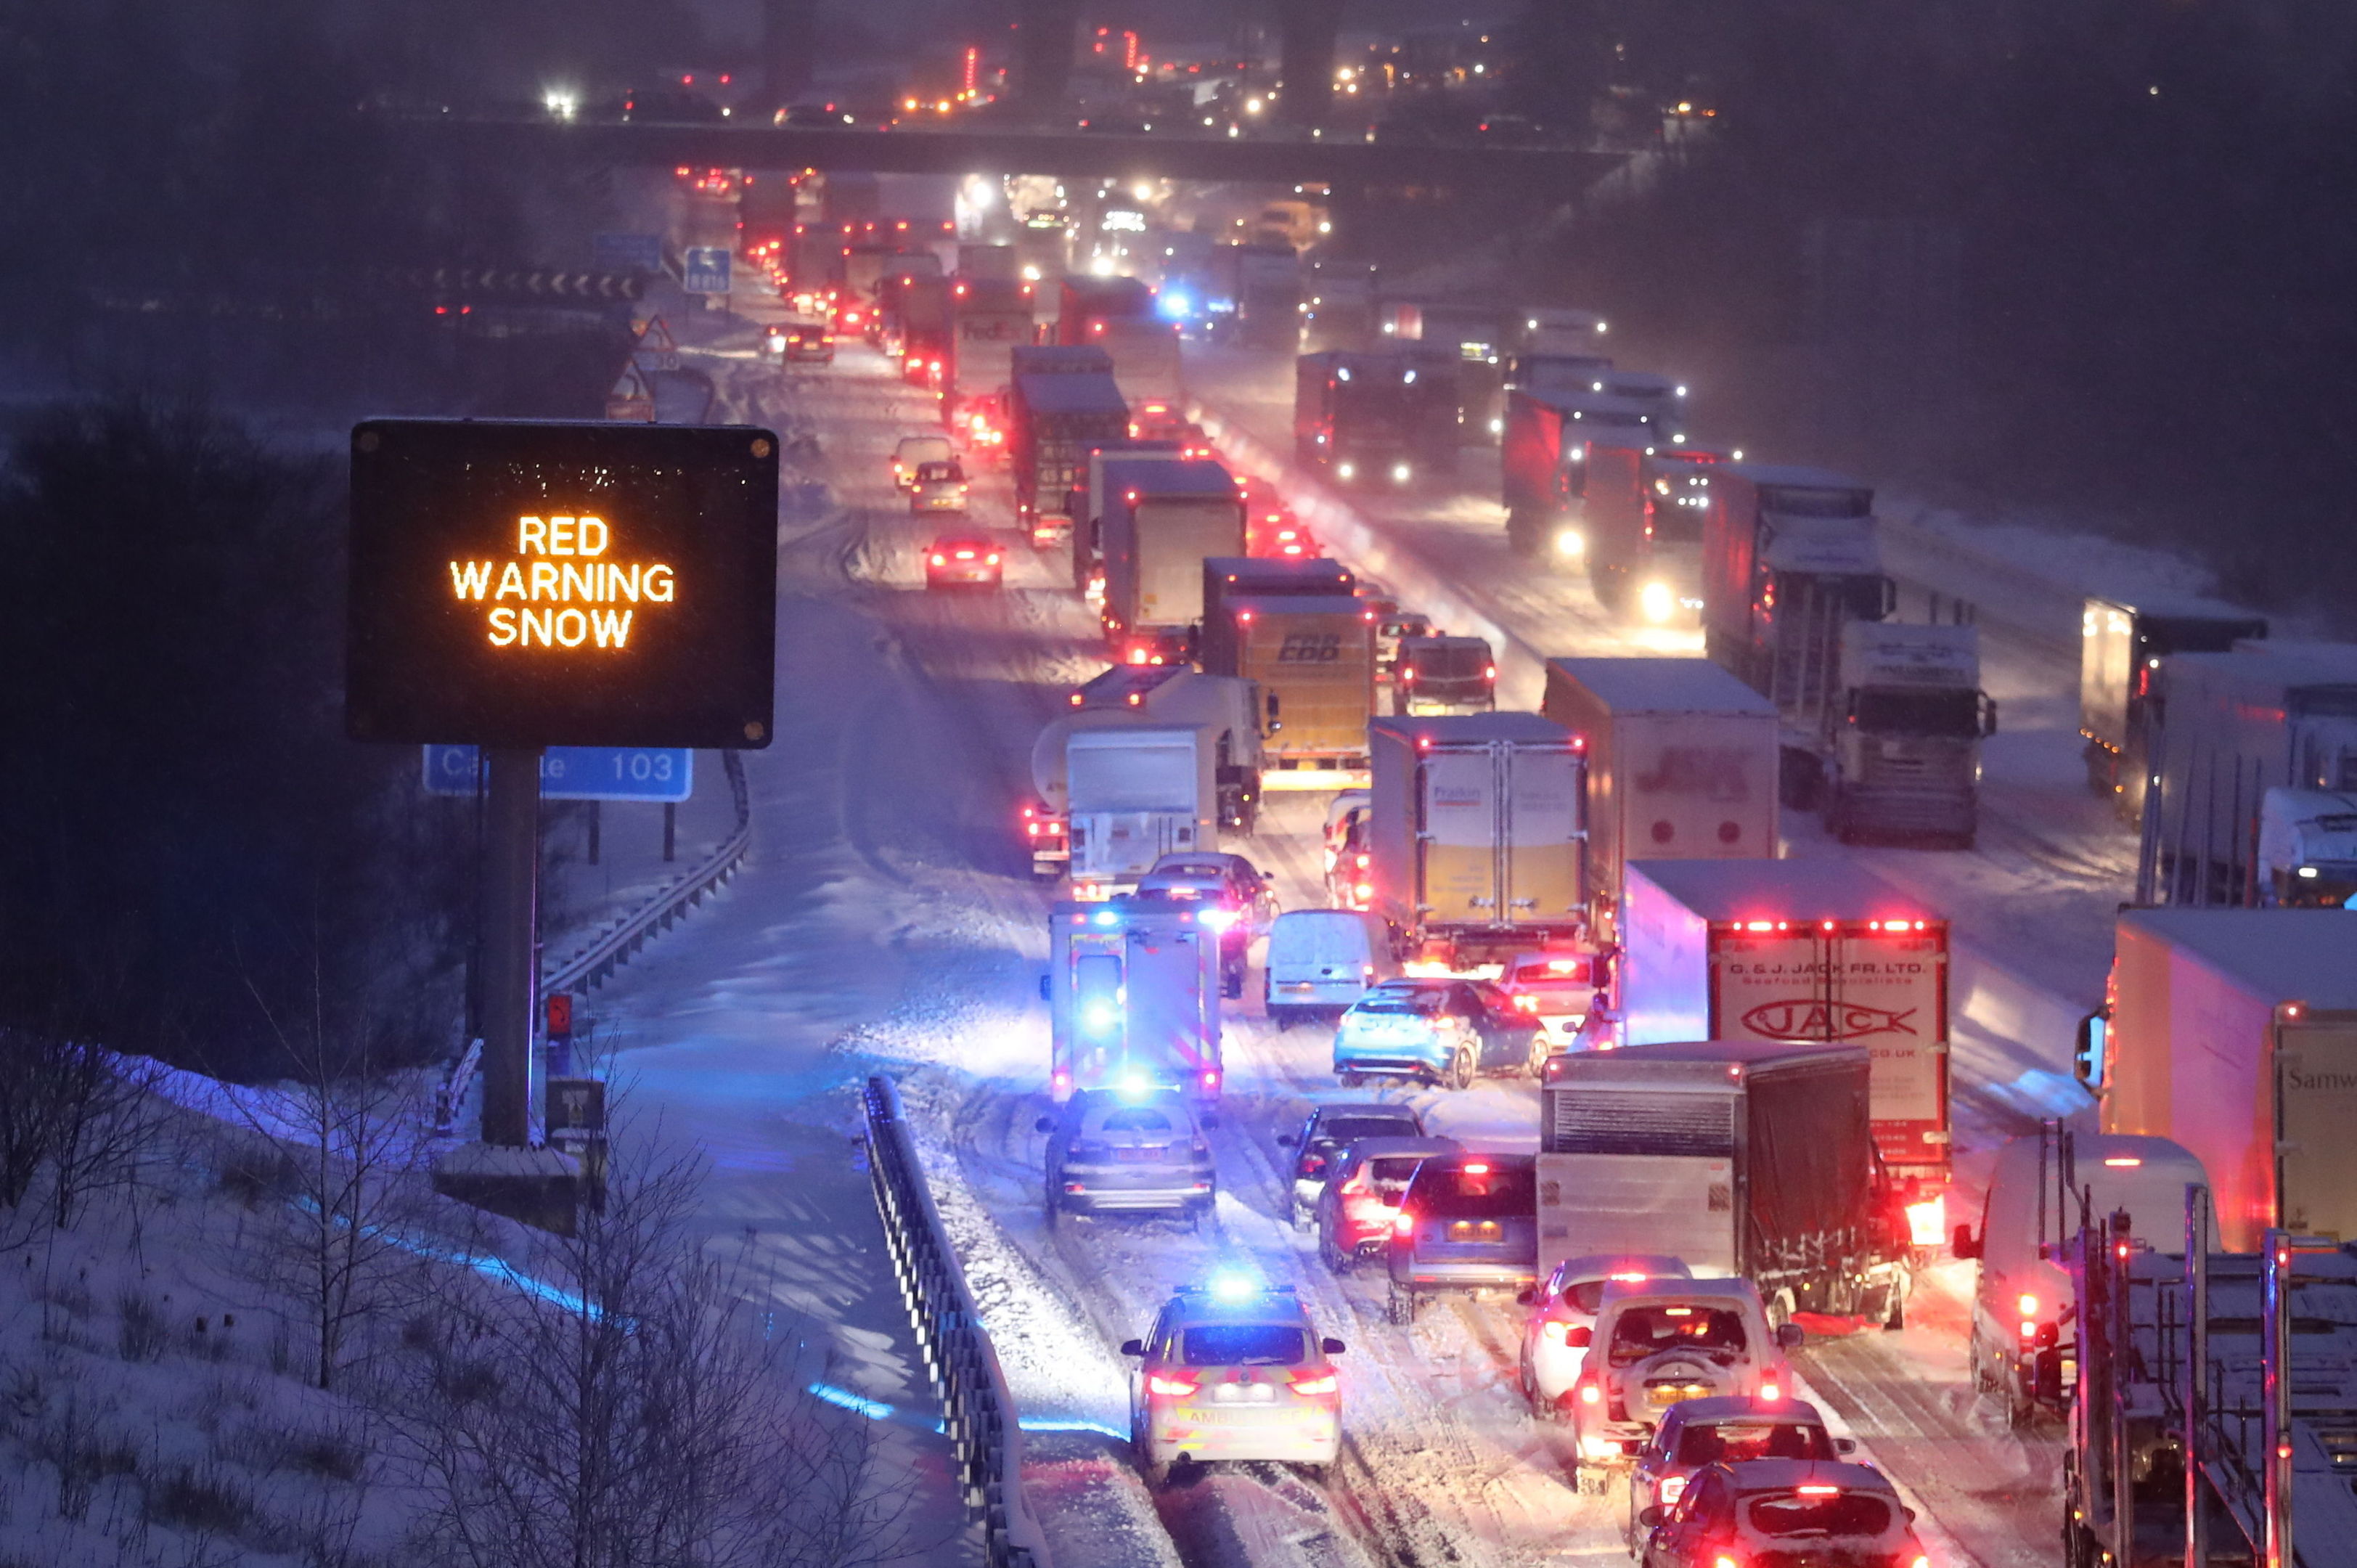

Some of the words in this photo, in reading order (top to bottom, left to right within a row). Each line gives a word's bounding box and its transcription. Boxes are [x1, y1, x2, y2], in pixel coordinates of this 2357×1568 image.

[519, 516, 608, 556] RED
[450, 561, 674, 603] WARNING
[489, 608, 632, 648] SNOW
[613, 752, 672, 781] 103
[1753, 964, 1766, 973] &
[1771, 964, 1787, 973] J.
[1792, 964, 1844, 974] JACK
[1887, 964, 1926, 973] LTD.
[1762, 1007, 1917, 1036] JACK
